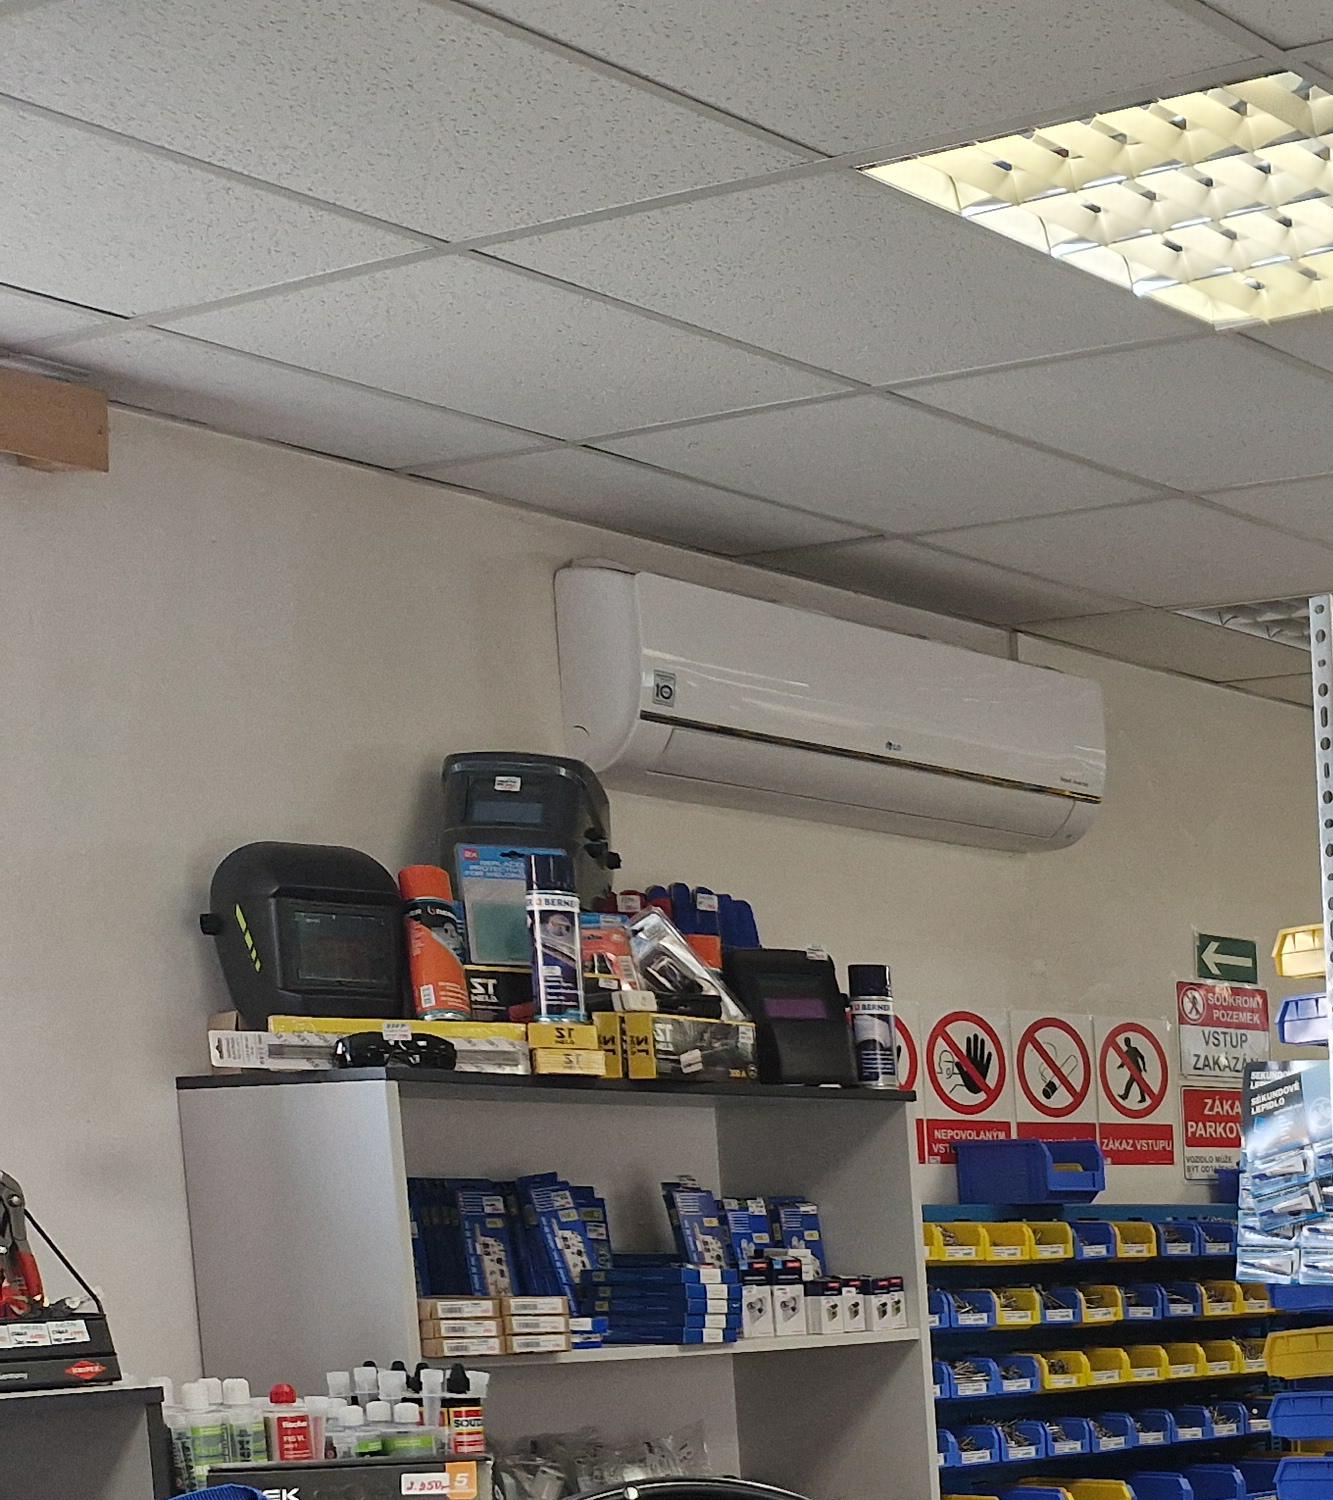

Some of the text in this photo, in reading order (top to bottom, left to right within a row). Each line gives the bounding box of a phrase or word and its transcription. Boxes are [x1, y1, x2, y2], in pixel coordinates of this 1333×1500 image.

[1213, 1010, 1261, 1025] POZEMEK
[1202, 1030, 1248, 1047] VSTUP
[1204, 1096, 1243, 1116] ZÁKA
[1251, 1097, 1285, 1115] LEPIDLO
[934, 1127, 1006, 1141] NEPOVOLANÝM
[933, 1143, 957, 1154] VST
[1102, 1138, 1133, 1150] ZÁKAZ
[1135, 1139, 1173, 1151] VSTUPU
[454, 1418, 483, 1429] SOUD
[454, 1473, 469, 1488] 5
